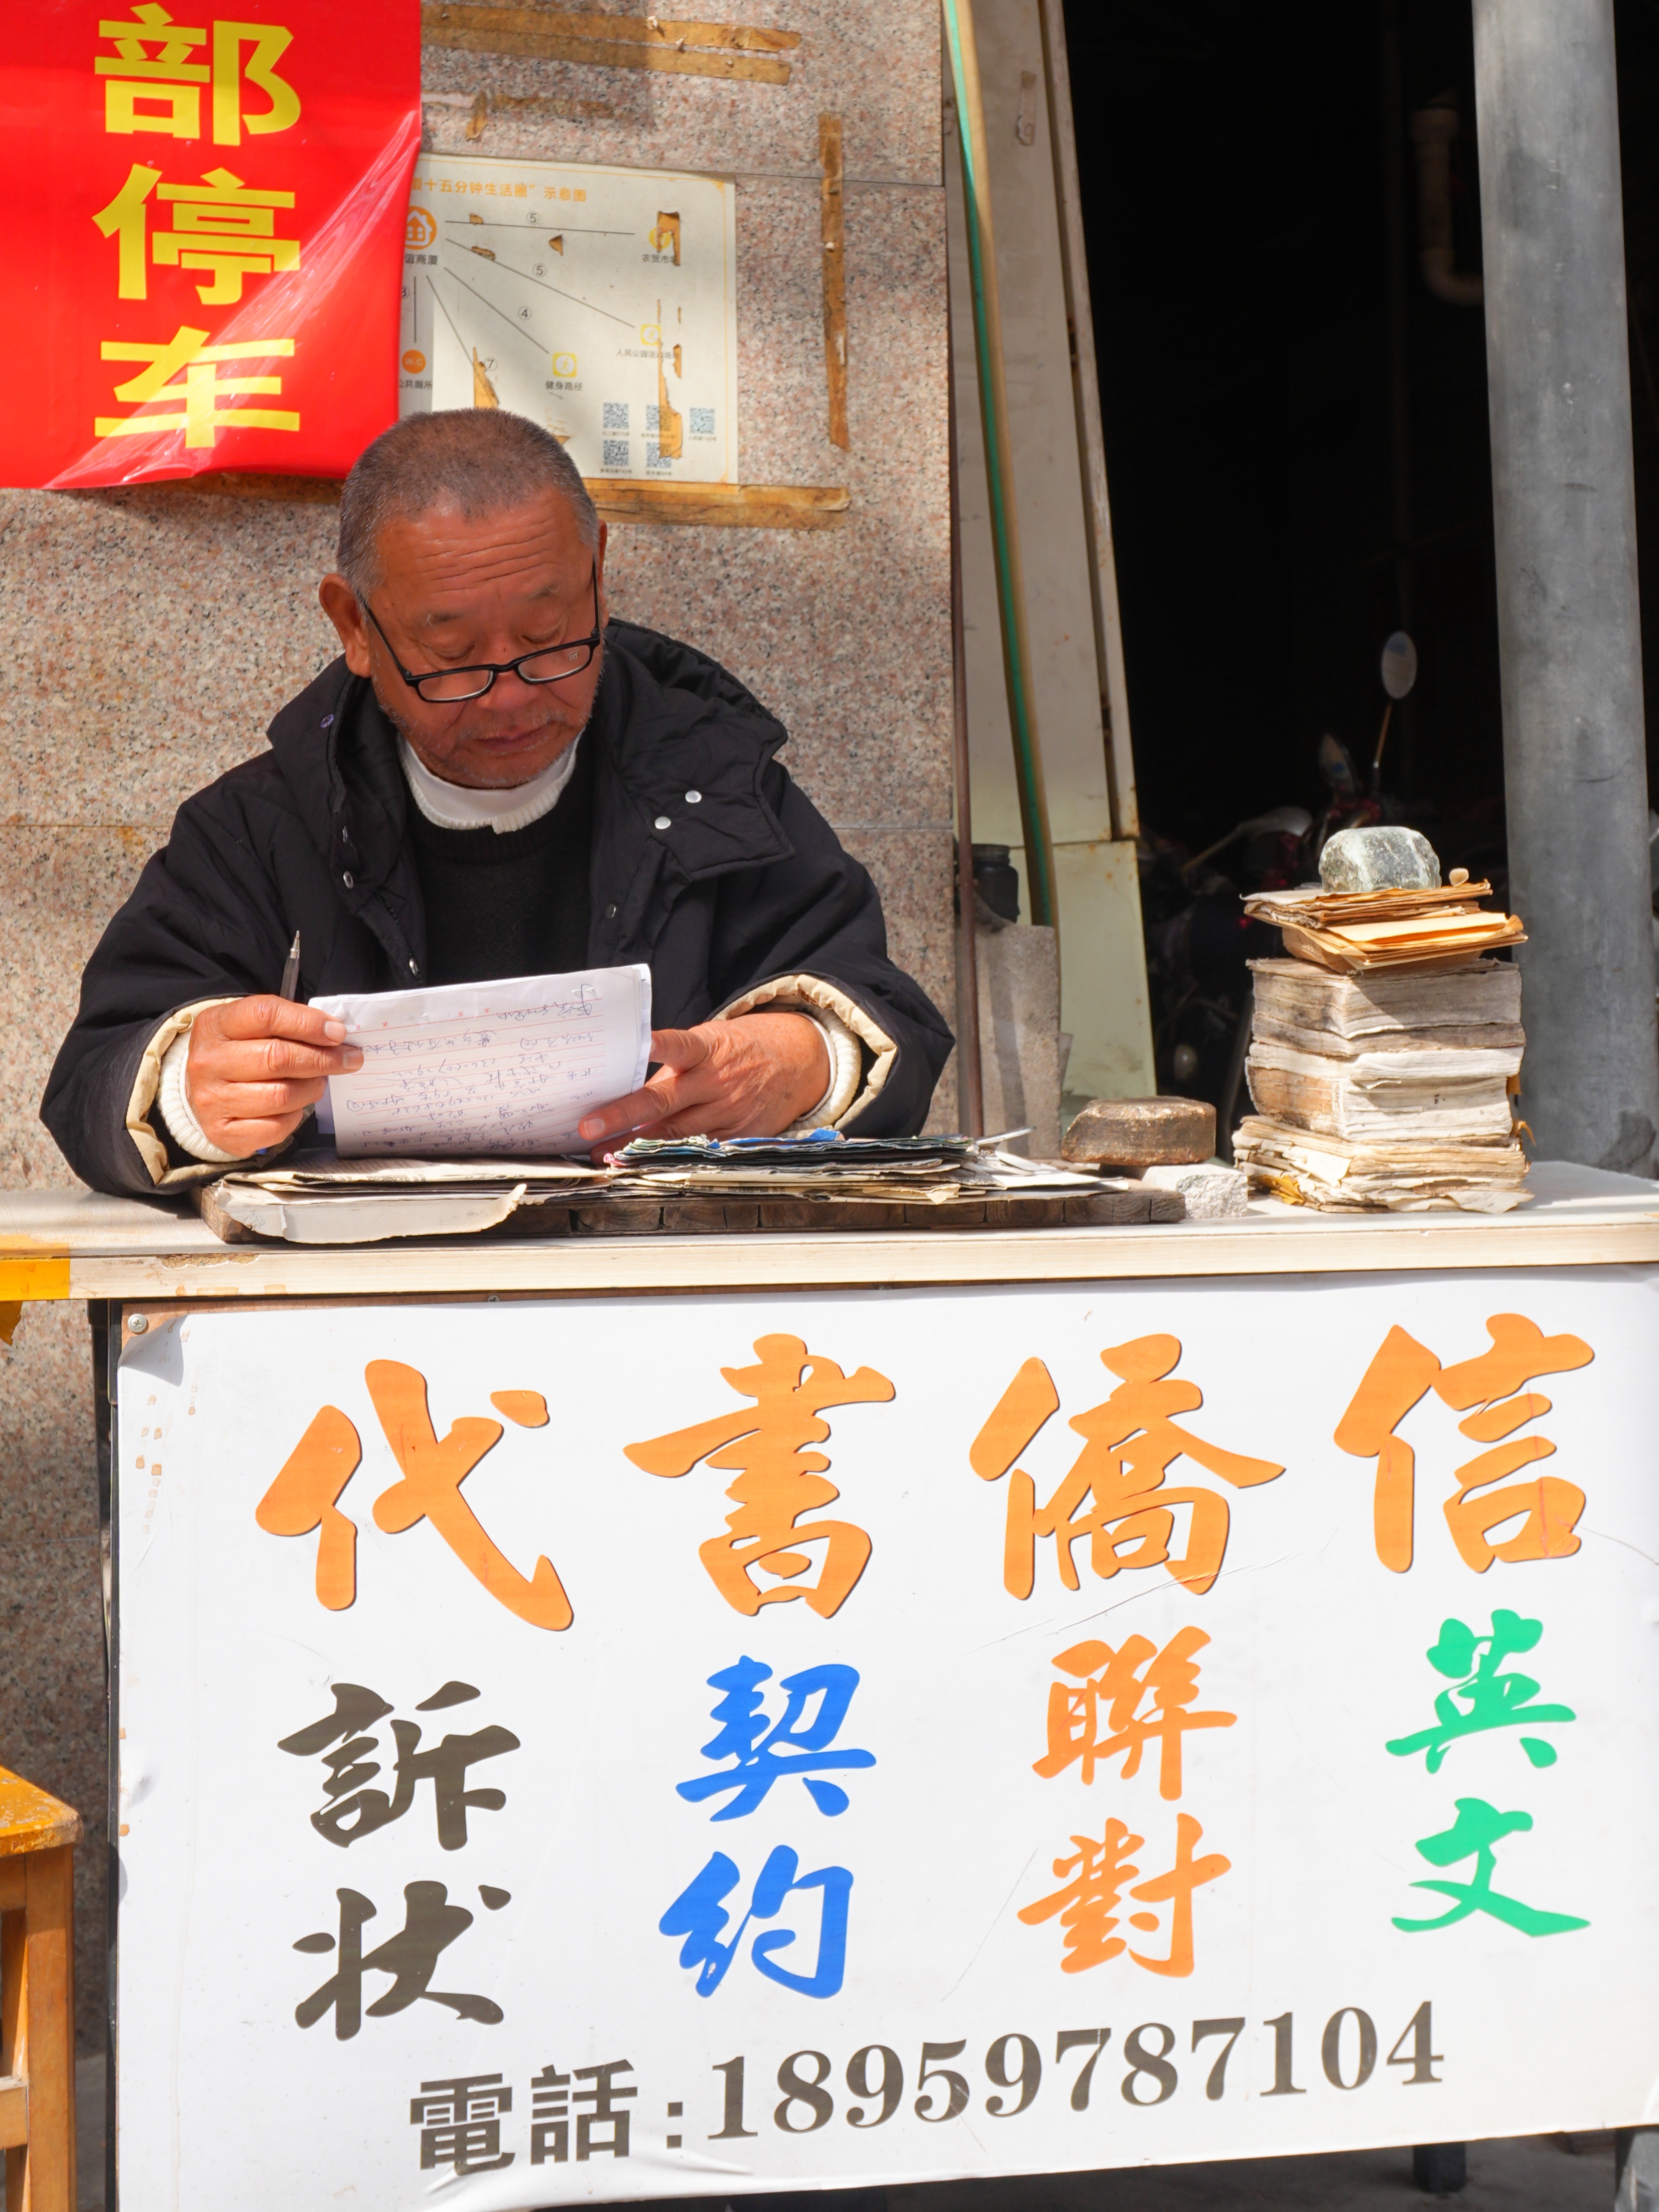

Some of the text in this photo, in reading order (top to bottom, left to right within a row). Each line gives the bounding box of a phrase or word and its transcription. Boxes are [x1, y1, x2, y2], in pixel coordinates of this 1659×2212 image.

[93, 3, 301, 448] 部停车
[545, 380, 583, 391] 健身路径
[255, 1313, 1595, 1631] 代書僑信
[659, 1655, 877, 1999] 契約
[1017, 1626, 1237, 1978] 聯對
[1386, 1609, 1591, 1937] 英文
